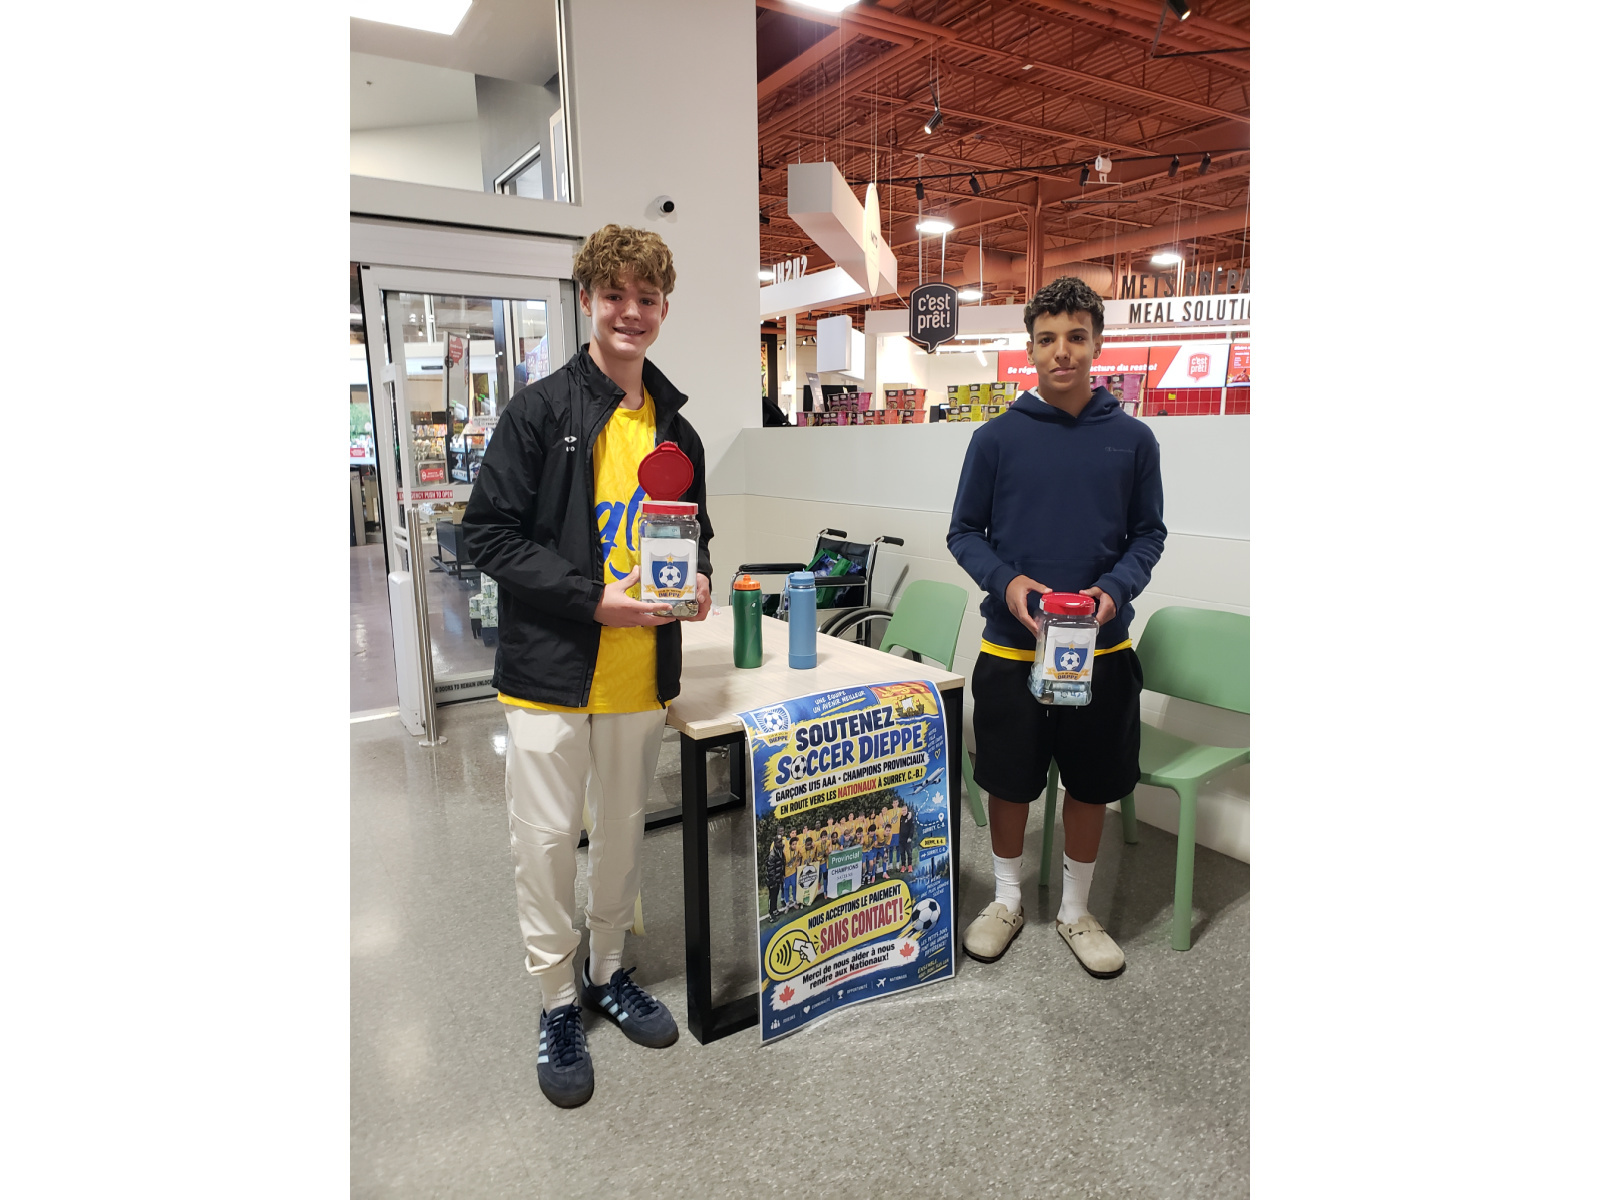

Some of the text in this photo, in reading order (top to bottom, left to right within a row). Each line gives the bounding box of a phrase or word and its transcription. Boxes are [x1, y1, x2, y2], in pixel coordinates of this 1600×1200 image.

[918, 293, 950, 311] c'est
[1121, 273, 1174, 300] METS
[918, 310, 950, 334] prêt!
[1130, 298, 1250, 324] MEAL SOLUTI
[822, 700, 841, 710] AVENIR
[842, 691, 866, 703] MEILLEUR
[769, 735, 788, 744] DIEPPE
[796, 706, 895, 751] SOUTENEZ
[859, 724, 923, 764] DIEPPE
[776, 753, 925, 802] GARÇONS U15 AAA CHAMPIONS PROVINCIAUX
[780, 804, 788, 815] EN
[789, 798, 808, 811] ROUTE
[809, 793, 825, 805] VERS
[826, 790, 837, 800] LES
[838, 780, 876, 798] NATIONAUX
[878, 777, 882, 788] À
[883, 773, 907, 787] SURREY,
[831, 851, 860, 864] Provincial
[831, 863, 858, 875] CHAMPIONS
[808, 884, 902, 929] NOUS ACCEPTONS LE PAIEMENT
[820, 918, 849, 954] SANS
[803, 944, 895, 984] Merci de nous aider à nous
[810, 953, 889, 990] rendre aux Nationaux!
